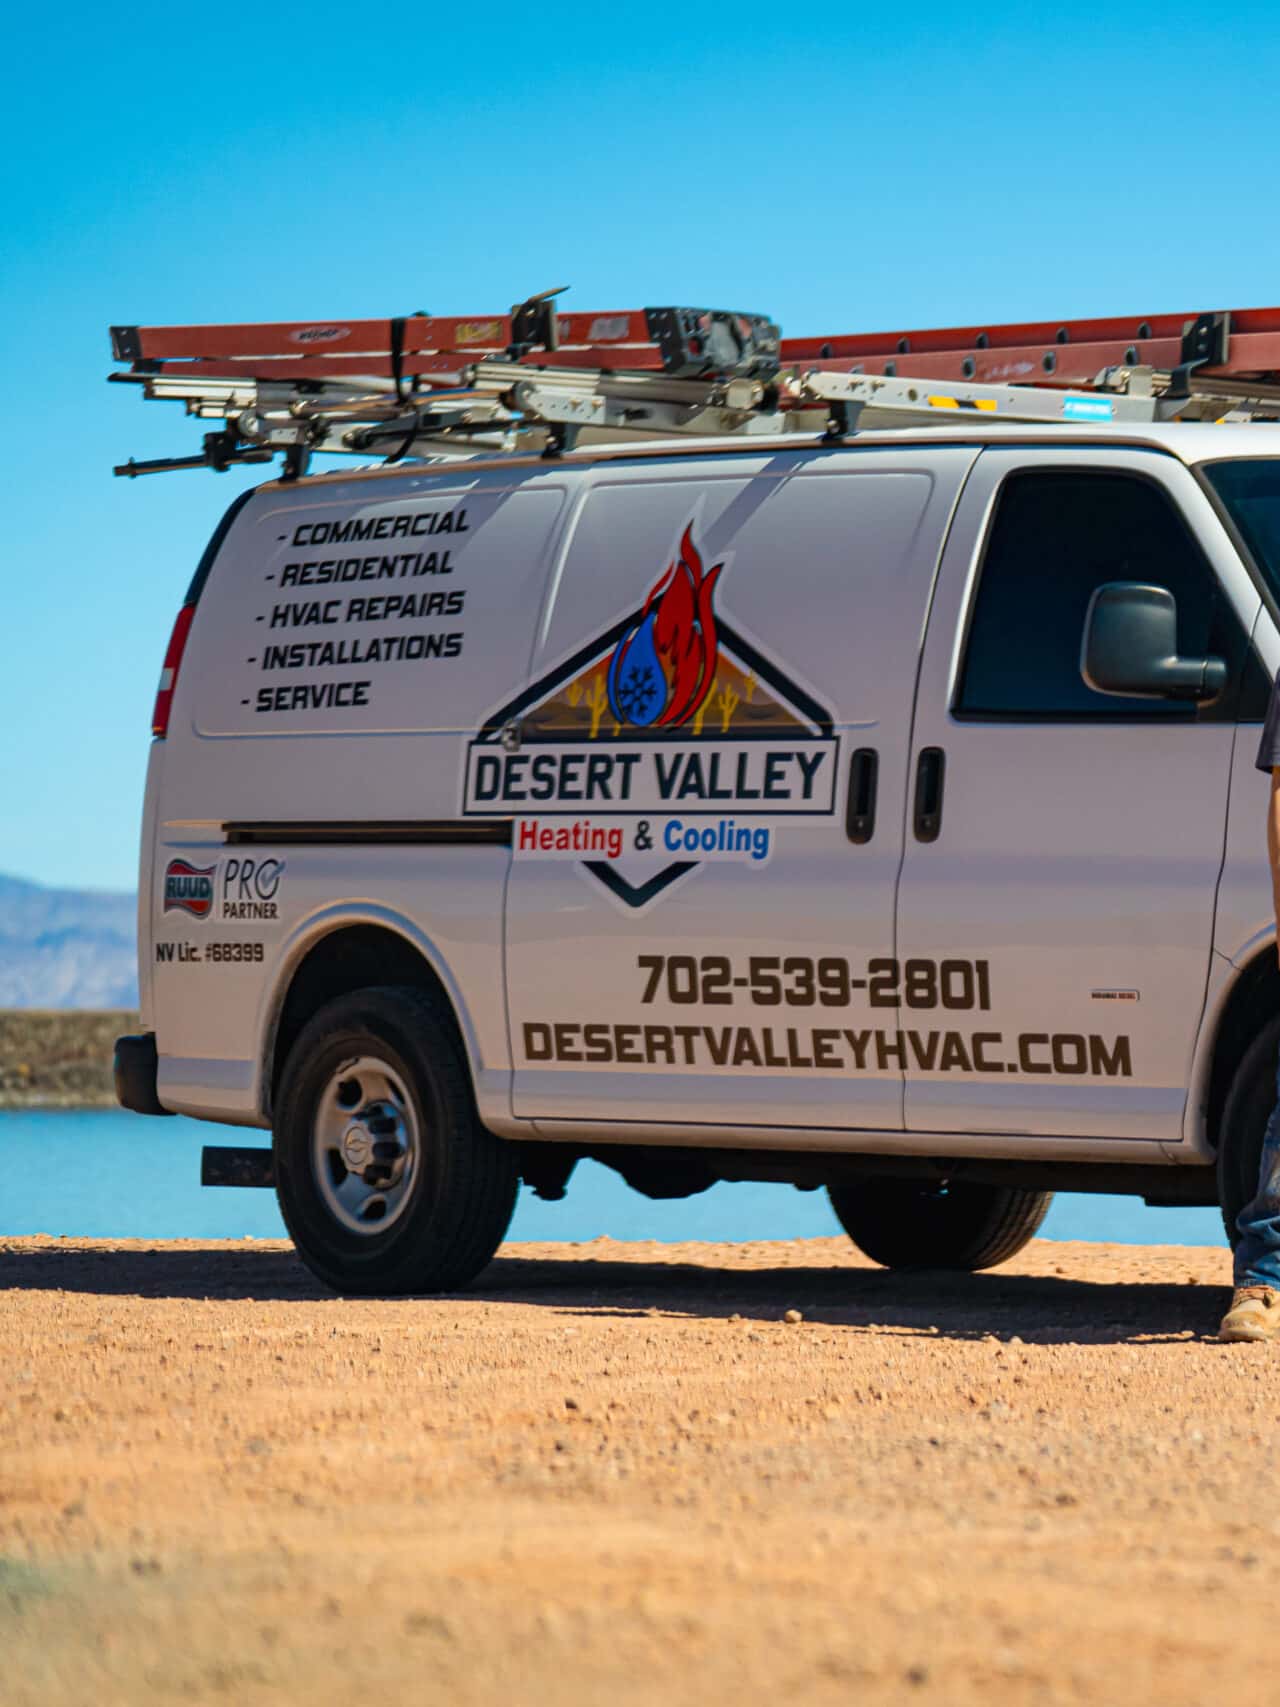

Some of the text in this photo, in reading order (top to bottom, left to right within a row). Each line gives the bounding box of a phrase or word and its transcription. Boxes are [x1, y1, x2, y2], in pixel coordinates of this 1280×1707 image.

[291, 508, 470, 548] COMMERCIAL
[279, 550, 454, 588] RESIDENTIAL
[269, 599, 342, 629] HVAC
[345, 590, 466, 623] REPAIRS
[261, 632, 464, 670] INSTALLATIONS
[255, 681, 371, 713] SERVICE
[474, 751, 827, 801] DESERT VALLEY
[518, 820, 770, 860] Heating & Cooling
[224, 858, 280, 900] PRO
[223, 902, 278, 919] PARTNER
[156, 943, 175, 962] NV
[177, 941, 202, 962] Lic.
[637, 955, 991, 1011] 702-539-2801
[522, 1022, 1133, 1078] DESERTVALLEYHVAC.COM
